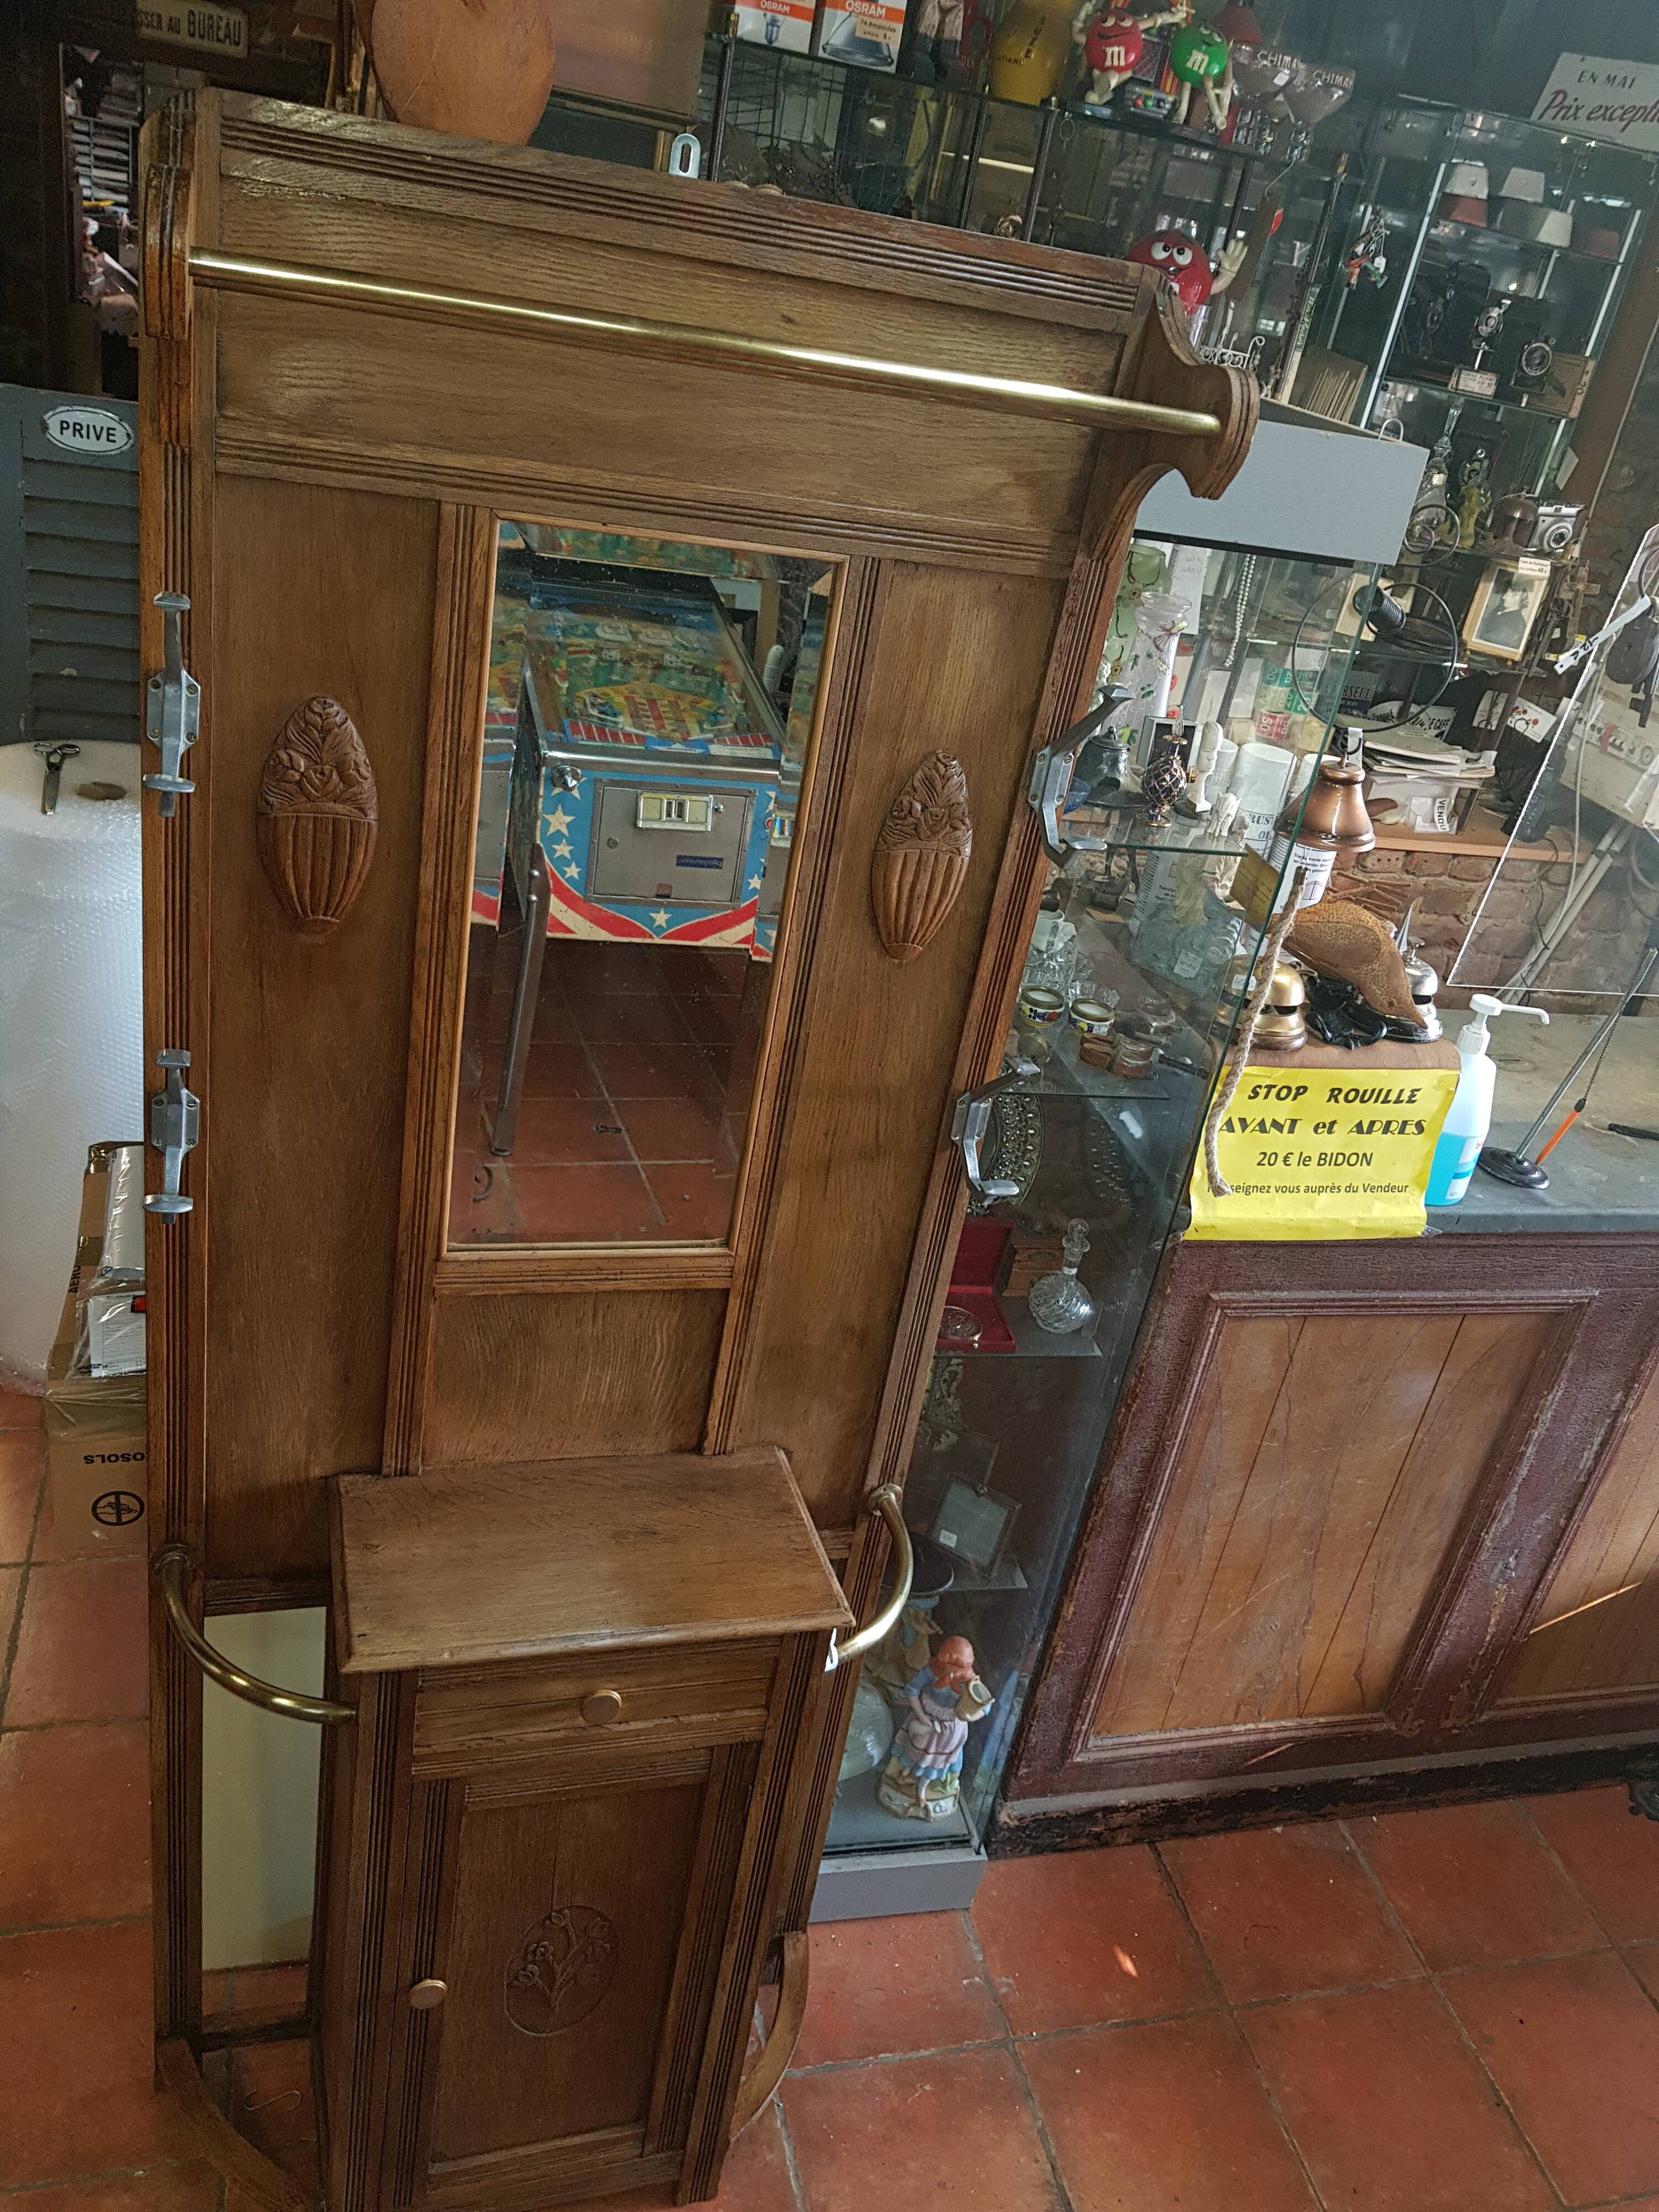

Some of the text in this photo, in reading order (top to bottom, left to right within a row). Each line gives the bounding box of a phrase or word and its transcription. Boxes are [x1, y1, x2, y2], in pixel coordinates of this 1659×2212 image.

[760, 0, 790, 13] OSRAM
[845, 0, 885, 18] OSRAM
[168, 16, 181, 34] AU
[187, 9, 242, 46] BUREAU
[1105, 46, 1125, 66] m
[1186, 49, 1209, 75] m
[1578, 70, 1599, 84] EN
[1537, 88, 1585, 121] Prix
[60, 420, 117, 443] PRIVE
[1438, 800, 1447, 830] VENDU
[1248, 1084, 1422, 1104] STOP ROUILLE
[1218, 1118, 1427, 1135] AVANT et APRES
[1256, 1151, 1373, 1167] 20 € le BIDON
[1274, 1185, 1300, 1193] vous
[1303, 1182, 1342, 1196] auprès
[1345, 1182, 1359, 1193] du
[1363, 1182, 1409, 1193] Vendeur
[84, 1452, 145, 1464] OSOLS
